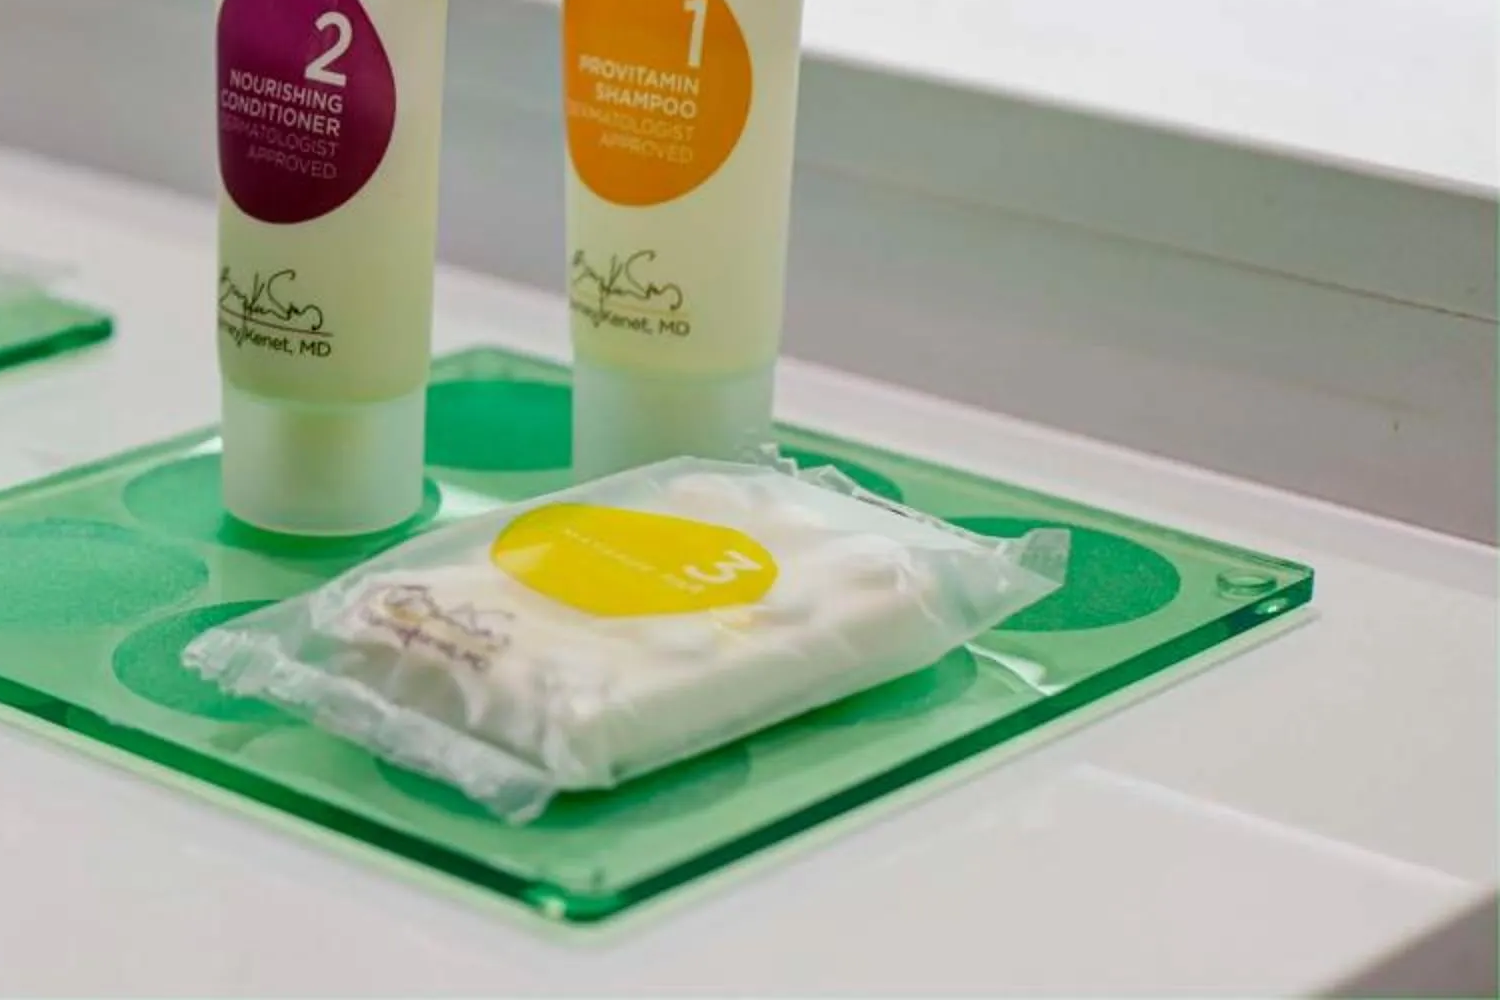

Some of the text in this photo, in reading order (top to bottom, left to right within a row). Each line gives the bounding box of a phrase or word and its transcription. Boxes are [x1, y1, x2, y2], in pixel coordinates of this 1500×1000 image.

[305, 11, 353, 87] 2
[230, 69, 343, 114] NOURISHING
[578, 53, 700, 96] PROVITAMIN
[221, 88, 341, 137] CONDITIONER
[596, 81, 697, 120] SHAMPOO
[247, 143, 337, 181] APPROVED
[598, 131, 694, 165] APPROVED
[299, 339, 332, 358] MD
[682, 547, 764, 586] 3
